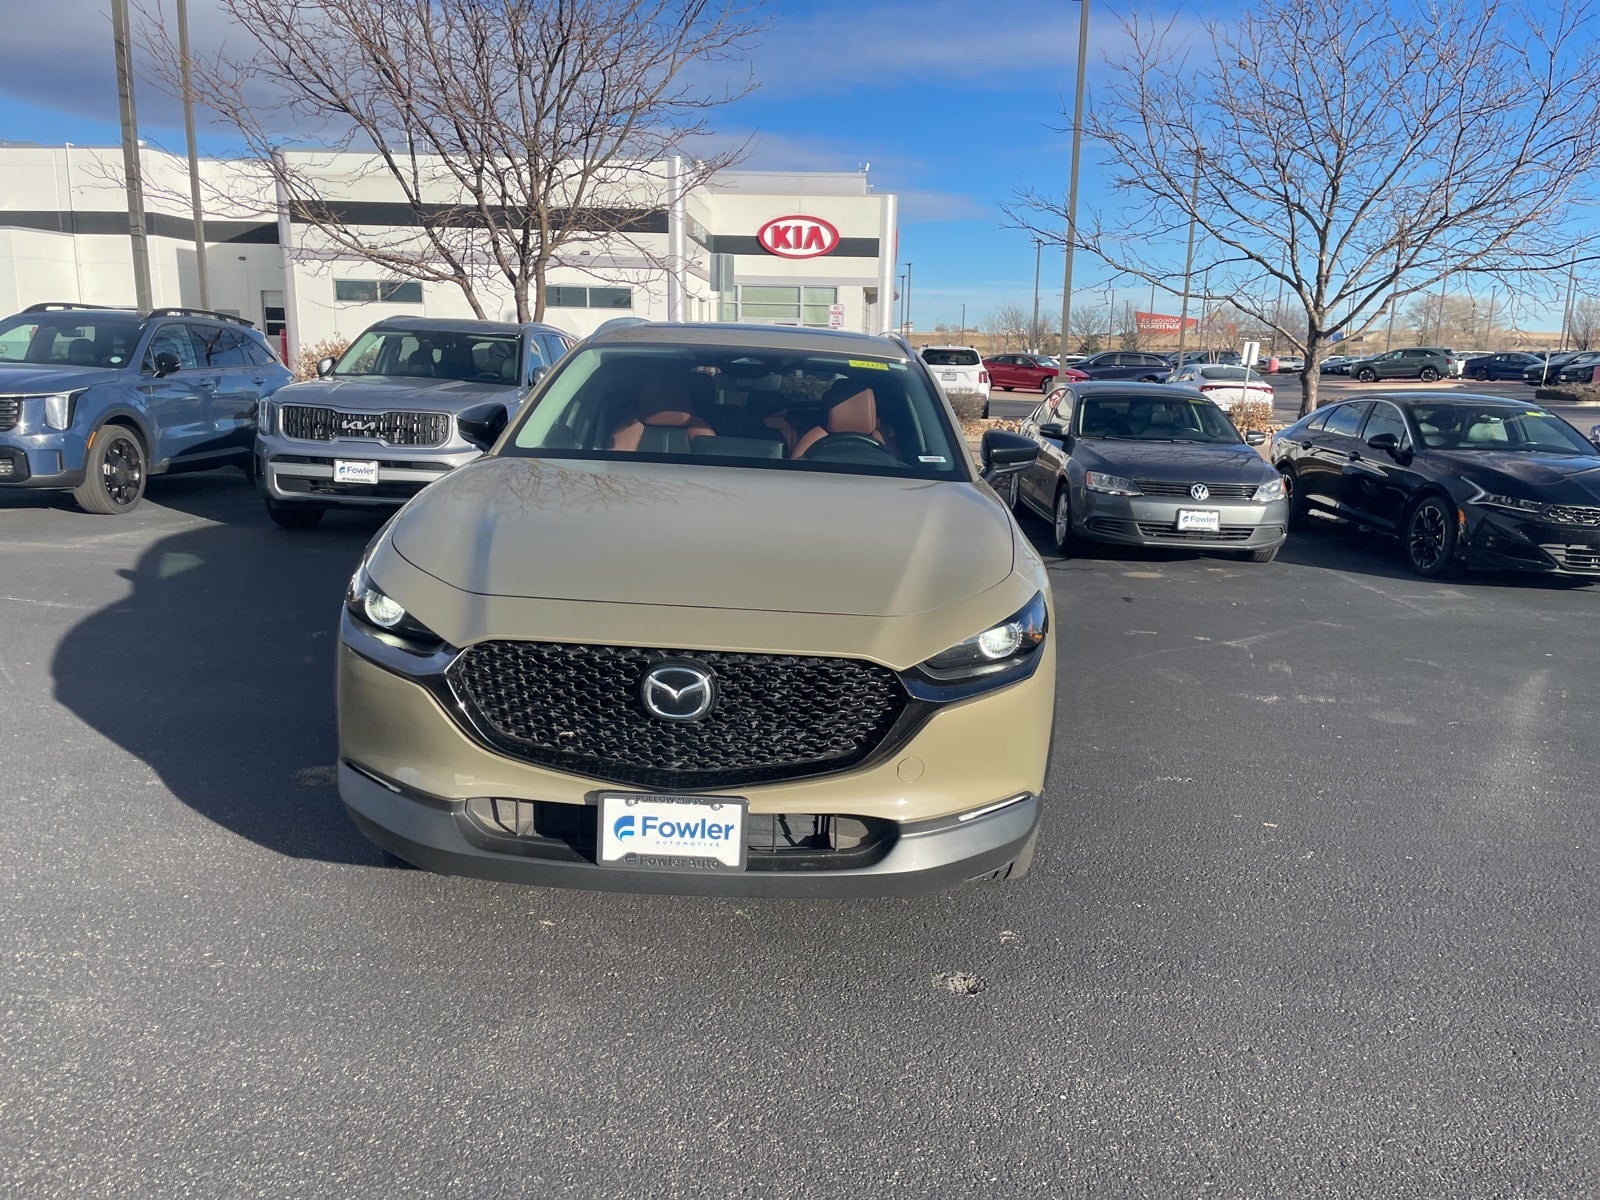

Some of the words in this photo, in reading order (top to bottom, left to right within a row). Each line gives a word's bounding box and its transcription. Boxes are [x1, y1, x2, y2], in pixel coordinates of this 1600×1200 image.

[770, 225, 826, 250] KIA
[346, 466, 374, 475] Fowler
[635, 795, 674, 803] FOLLOW
[641, 816, 735, 840] Fowler
[656, 840, 720, 848] AUTOMOTIVE
